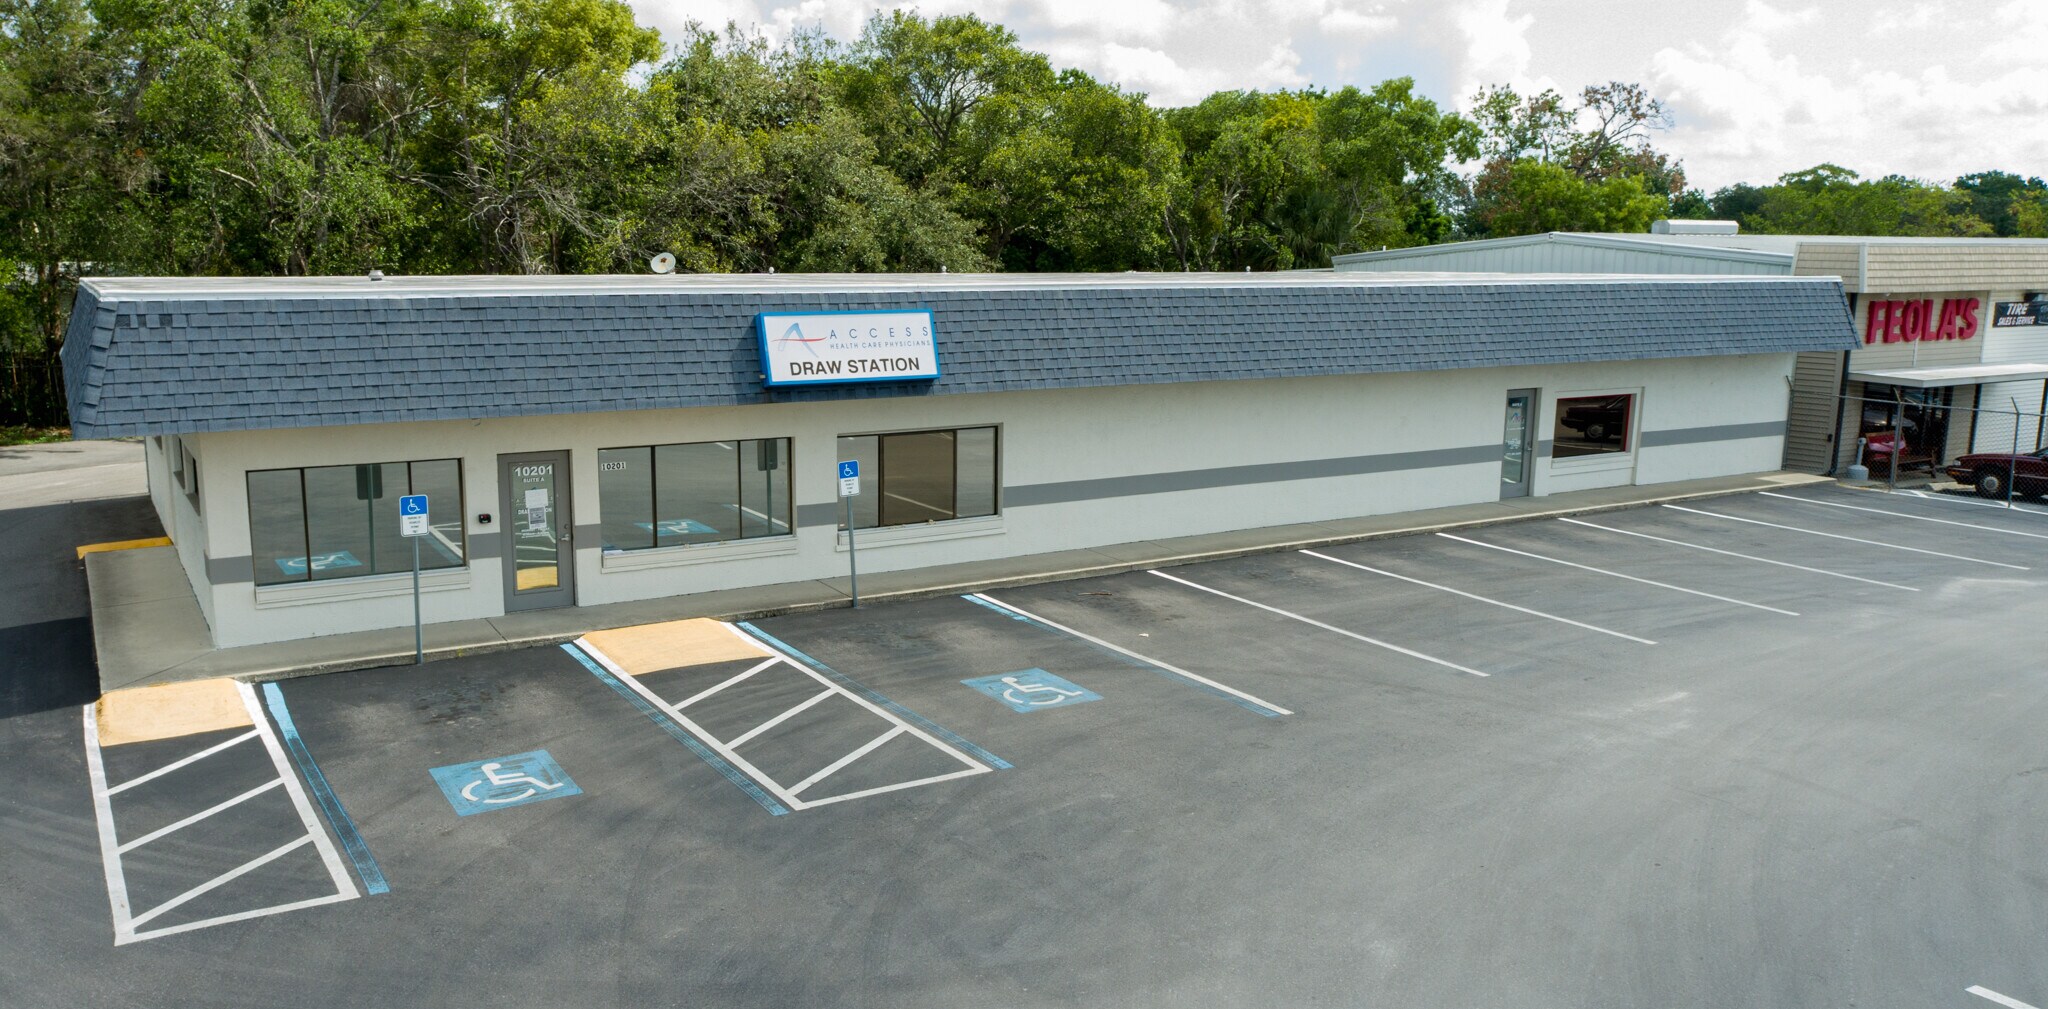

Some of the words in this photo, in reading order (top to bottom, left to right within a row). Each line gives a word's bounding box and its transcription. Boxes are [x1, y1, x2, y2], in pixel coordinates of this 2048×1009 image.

[2006, 302, 2030, 316] TIRE
[1865, 297, 1980, 345] FEOLA'S
[1997, 316, 2013, 326] SALES
[2016, 315, 2036, 326] SERVICE
[829, 326, 929, 340] ACCESS
[830, 342, 859, 350] HEALTH
[861, 341, 882, 349] CARE
[884, 339, 931, 348] PHYSICIANS
[789, 360, 842, 376] DRAW
[847, 357, 920, 374] STATION
[514, 464, 553, 477] 10201
[602, 462, 626, 471] 10201
